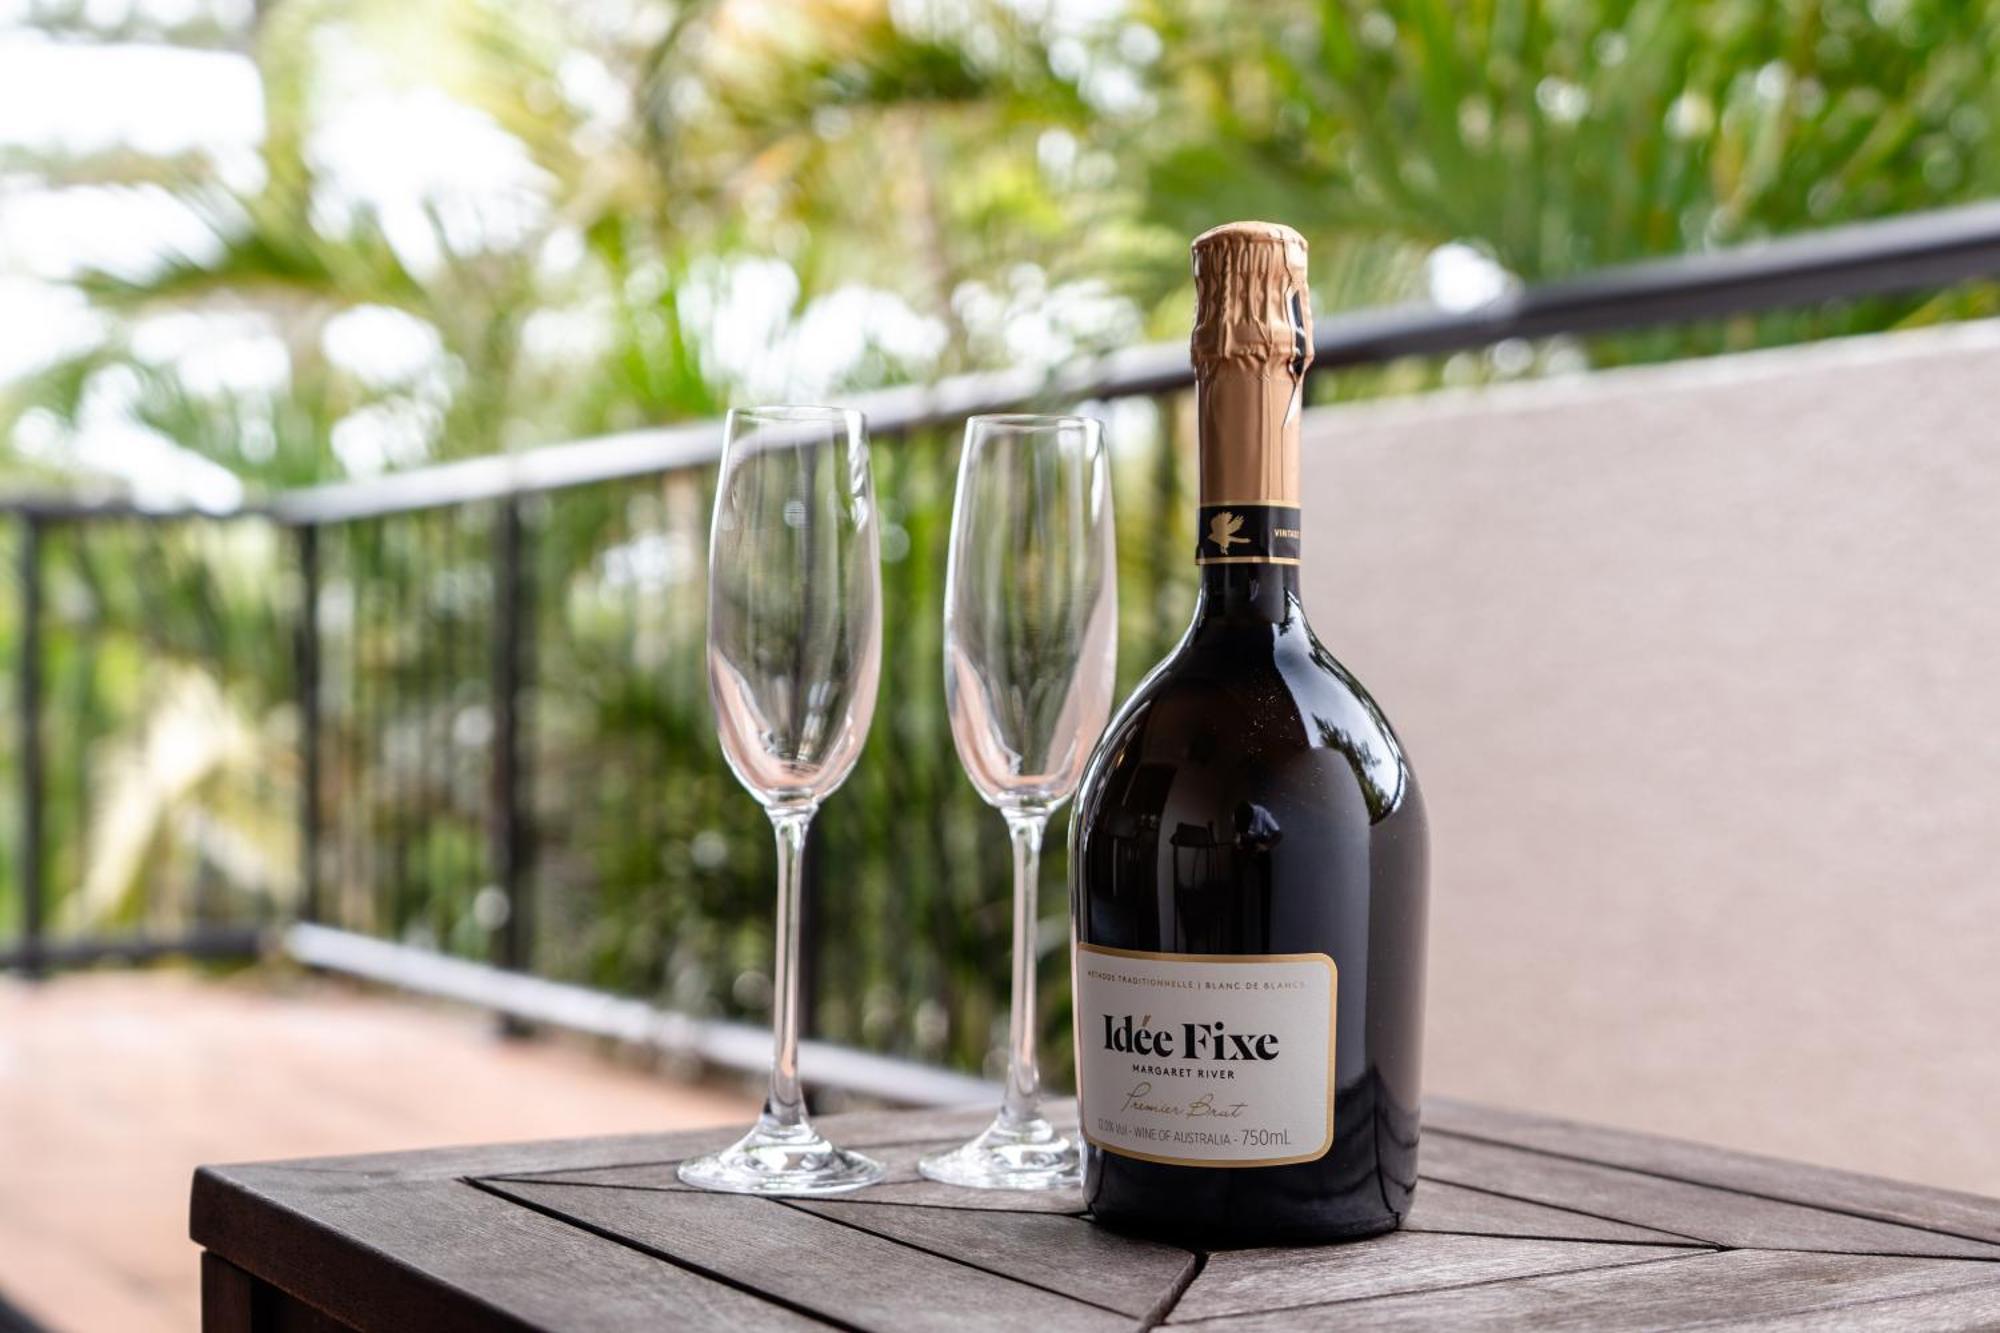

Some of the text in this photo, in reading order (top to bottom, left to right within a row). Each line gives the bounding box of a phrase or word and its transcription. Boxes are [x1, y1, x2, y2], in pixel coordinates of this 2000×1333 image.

[1118, 974, 1193, 989] TRADITIONNELLE
[1205, 981, 1241, 990] BLANC
[1245, 981, 1258, 990] DE
[1103, 1014, 1280, 1061] Idée Fixe
[1132, 1063, 1235, 1080] MARGARET RIVER
[1120, 1081, 1249, 1119] Premier Brut
[1134, 1126, 1156, 1140] WINE
[1158, 1128, 1171, 1141] OF
[1173, 1129, 1232, 1146] AUSTRALIA
[1241, 1128, 1292, 1146] 750mL
